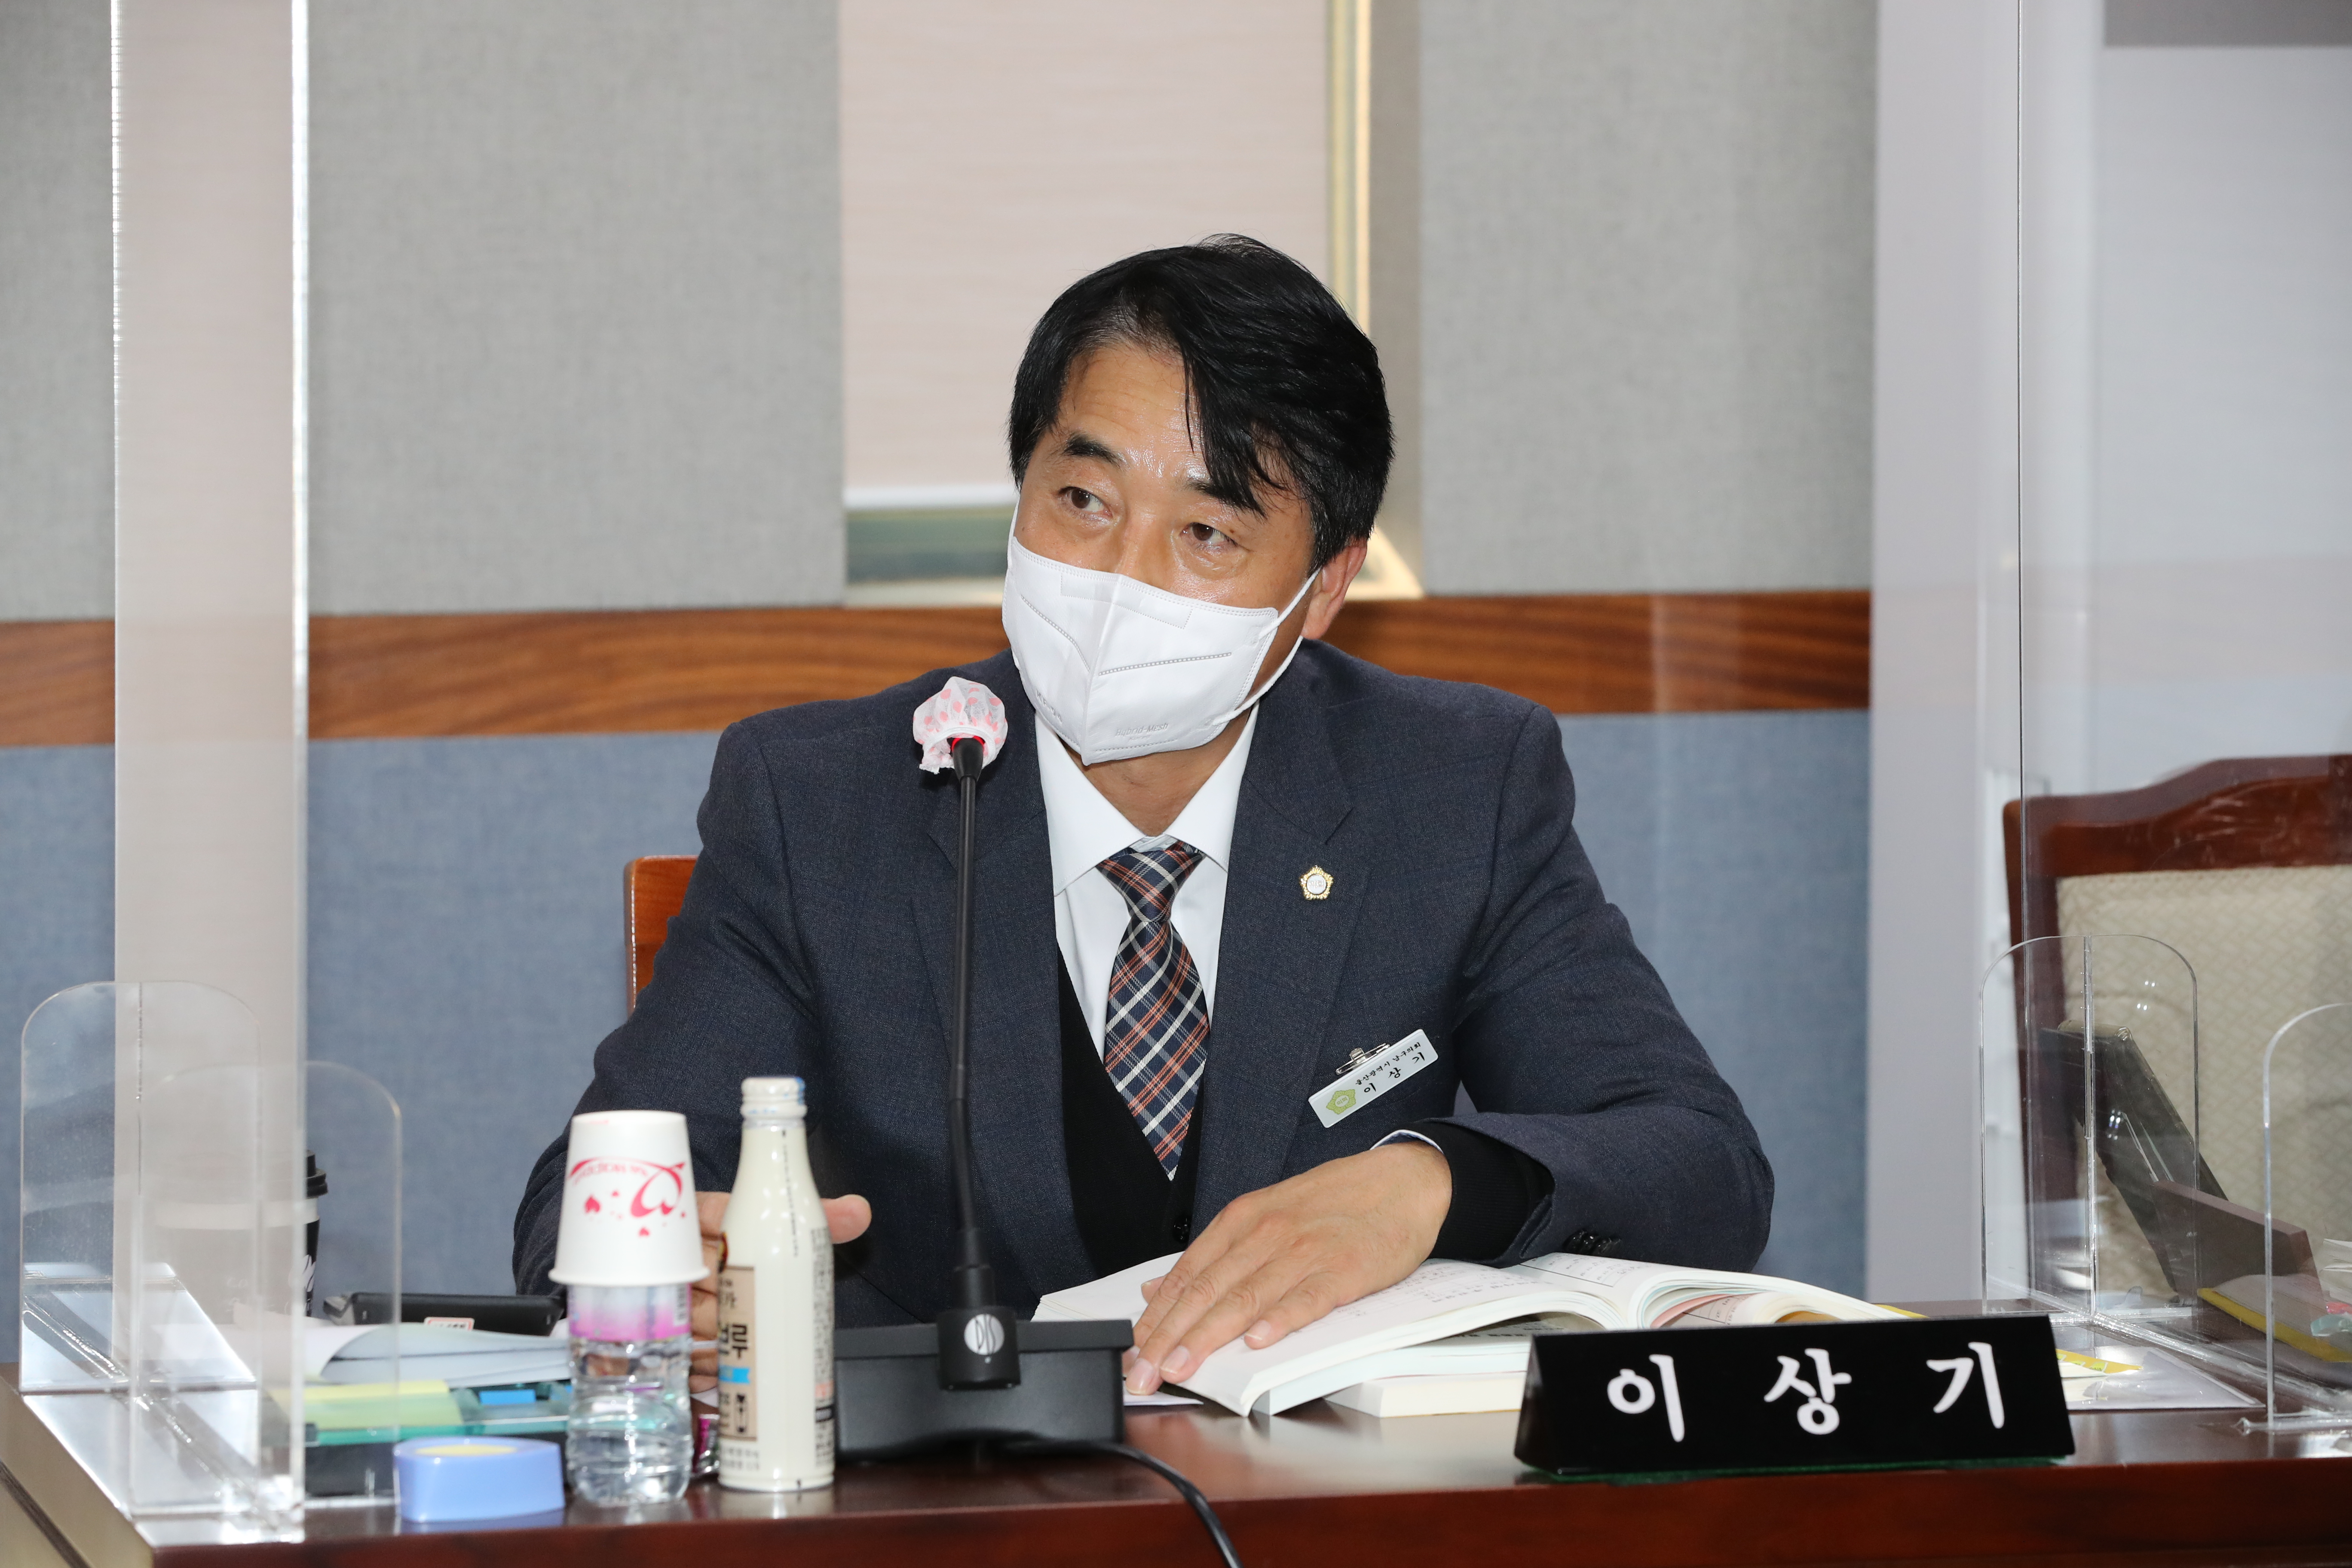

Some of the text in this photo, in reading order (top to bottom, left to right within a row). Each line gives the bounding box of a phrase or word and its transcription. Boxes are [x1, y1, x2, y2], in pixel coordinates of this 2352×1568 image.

[1115, 723, 1169, 736] Hybrid-Mesh
[1355, 1042, 1421, 1085] 울산광역시 남구의회
